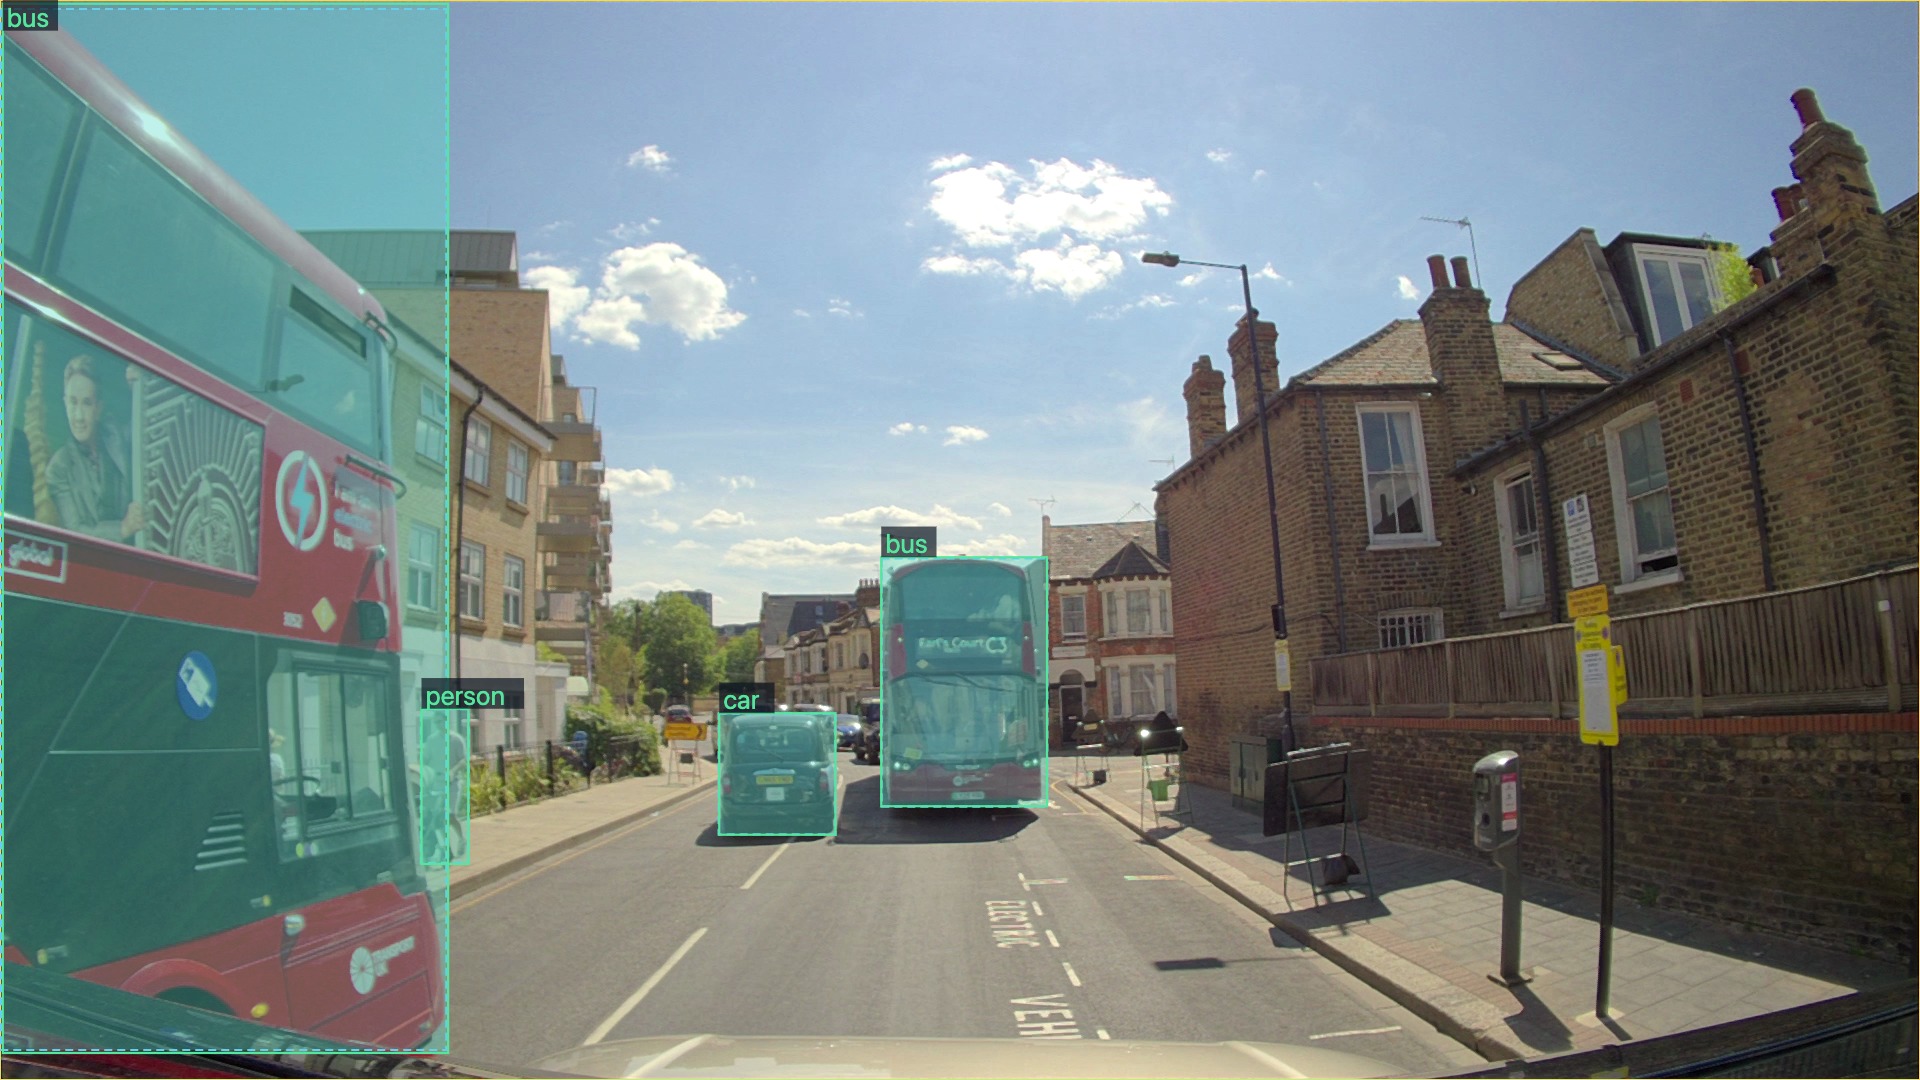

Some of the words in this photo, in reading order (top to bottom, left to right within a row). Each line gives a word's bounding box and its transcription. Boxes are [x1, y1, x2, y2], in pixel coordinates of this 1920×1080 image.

[9, 539, 53, 568] global
[333, 527, 355, 553] bus
[951, 636, 985, 649] Court
[986, 636, 1008, 655] C3
[985, 900, 1040, 948] ELECTRIC
